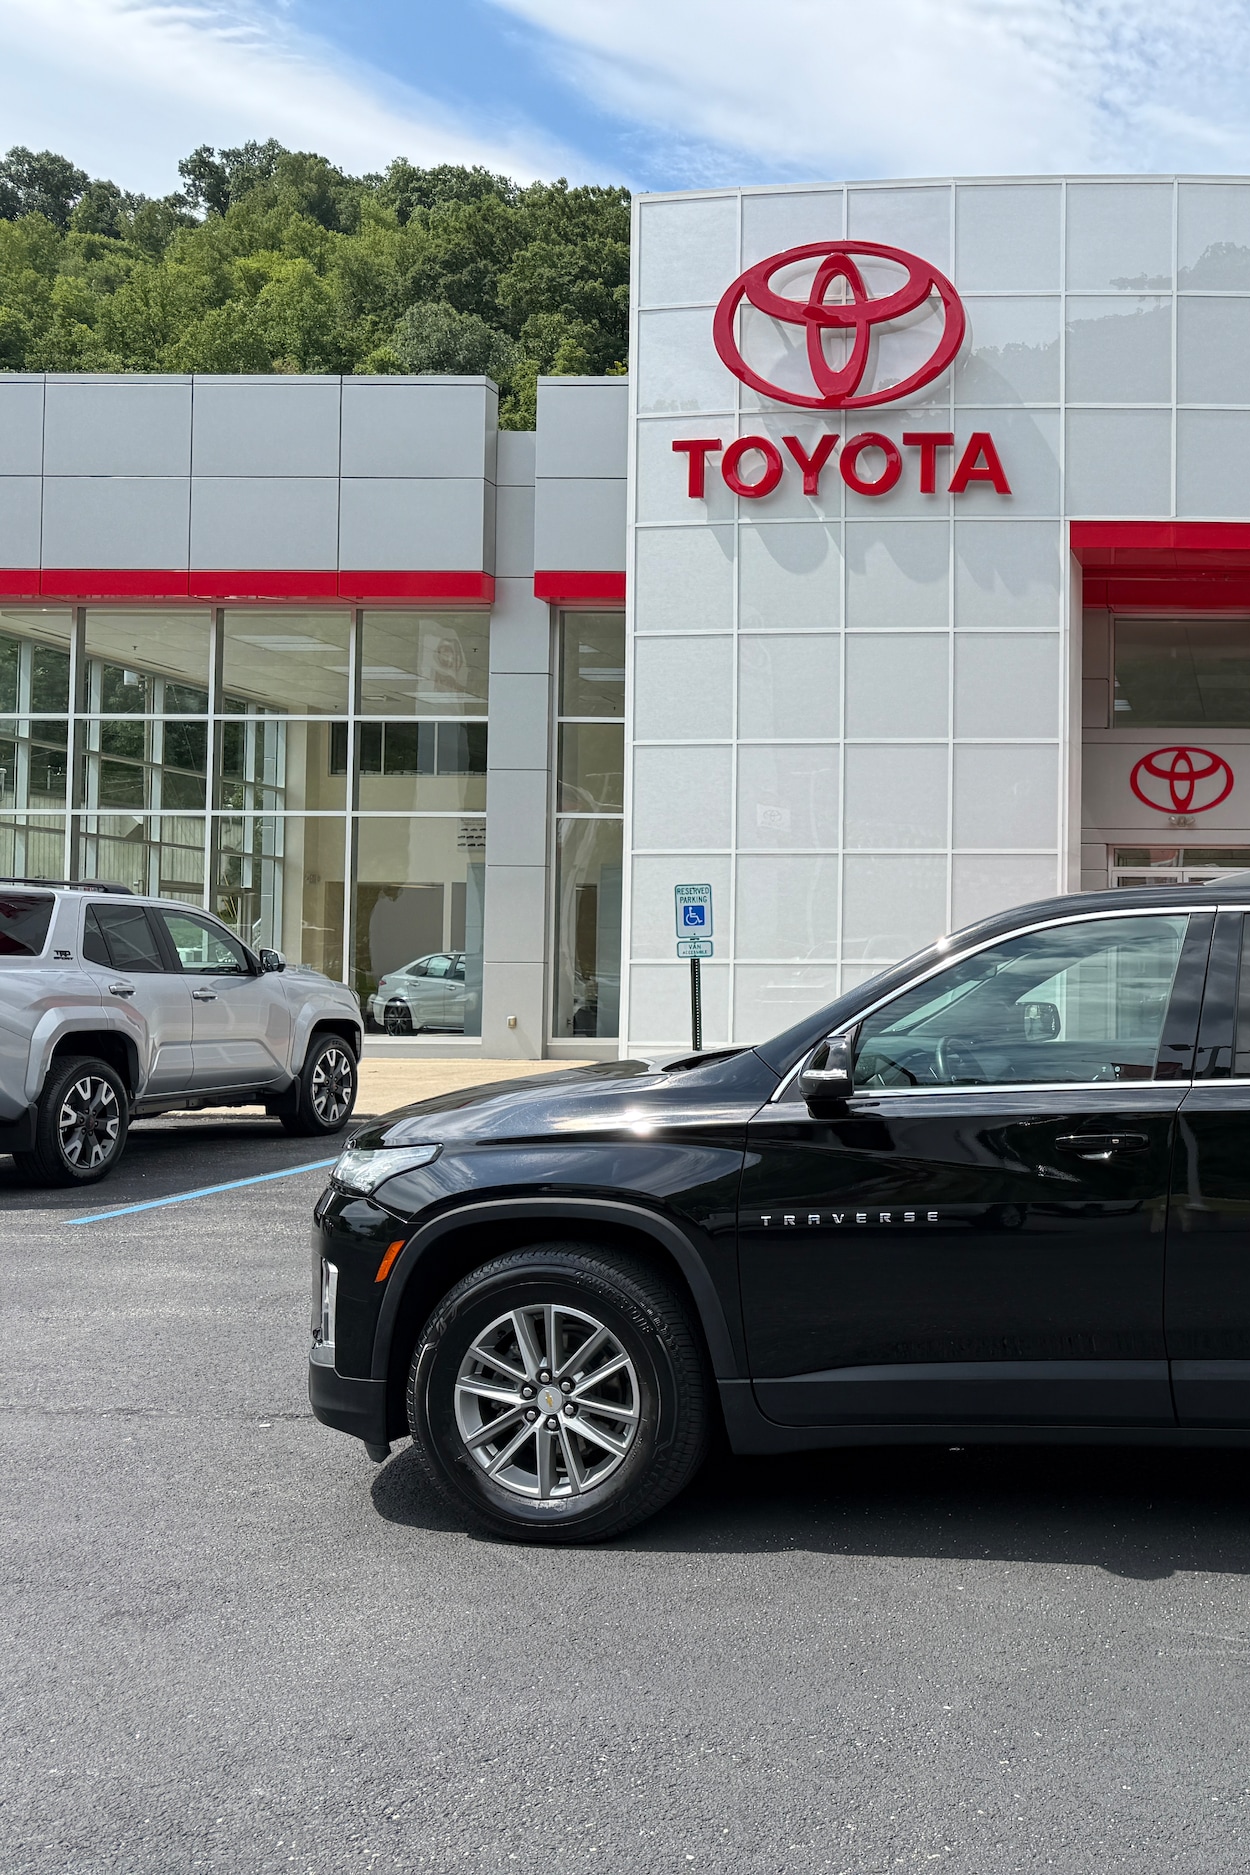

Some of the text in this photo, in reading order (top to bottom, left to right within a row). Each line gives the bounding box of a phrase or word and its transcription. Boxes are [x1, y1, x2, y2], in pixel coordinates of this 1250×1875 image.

[672, 432, 1012, 499] TOYOTA
[676, 886, 710, 895] RESERVED
[680, 895, 708, 904] PARKING
[760, 1211, 939, 1226] TRAVERSE
